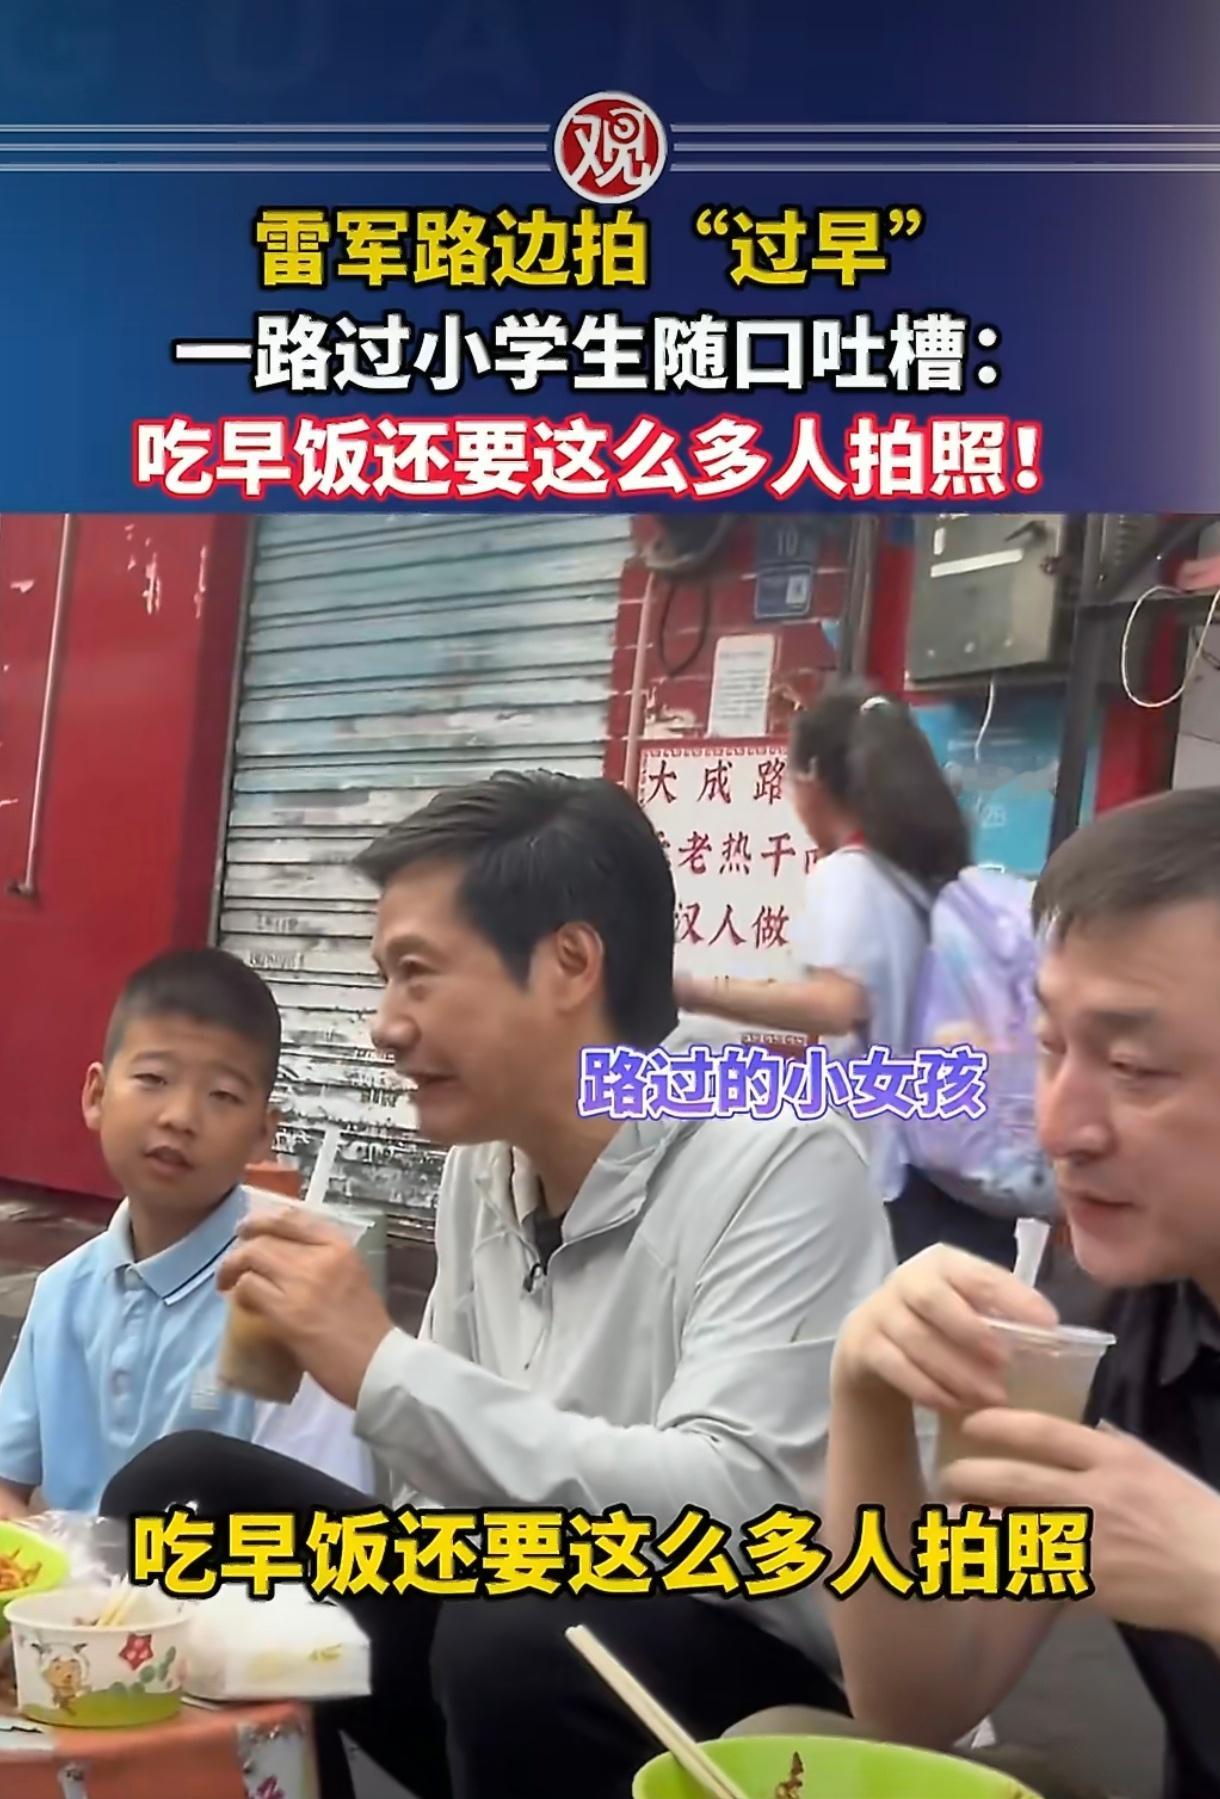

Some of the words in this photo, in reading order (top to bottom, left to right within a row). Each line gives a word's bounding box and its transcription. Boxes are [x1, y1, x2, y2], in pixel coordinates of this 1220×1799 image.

[646, 757, 787, 805] 大成路
[656, 830, 820, 877] 老热干
